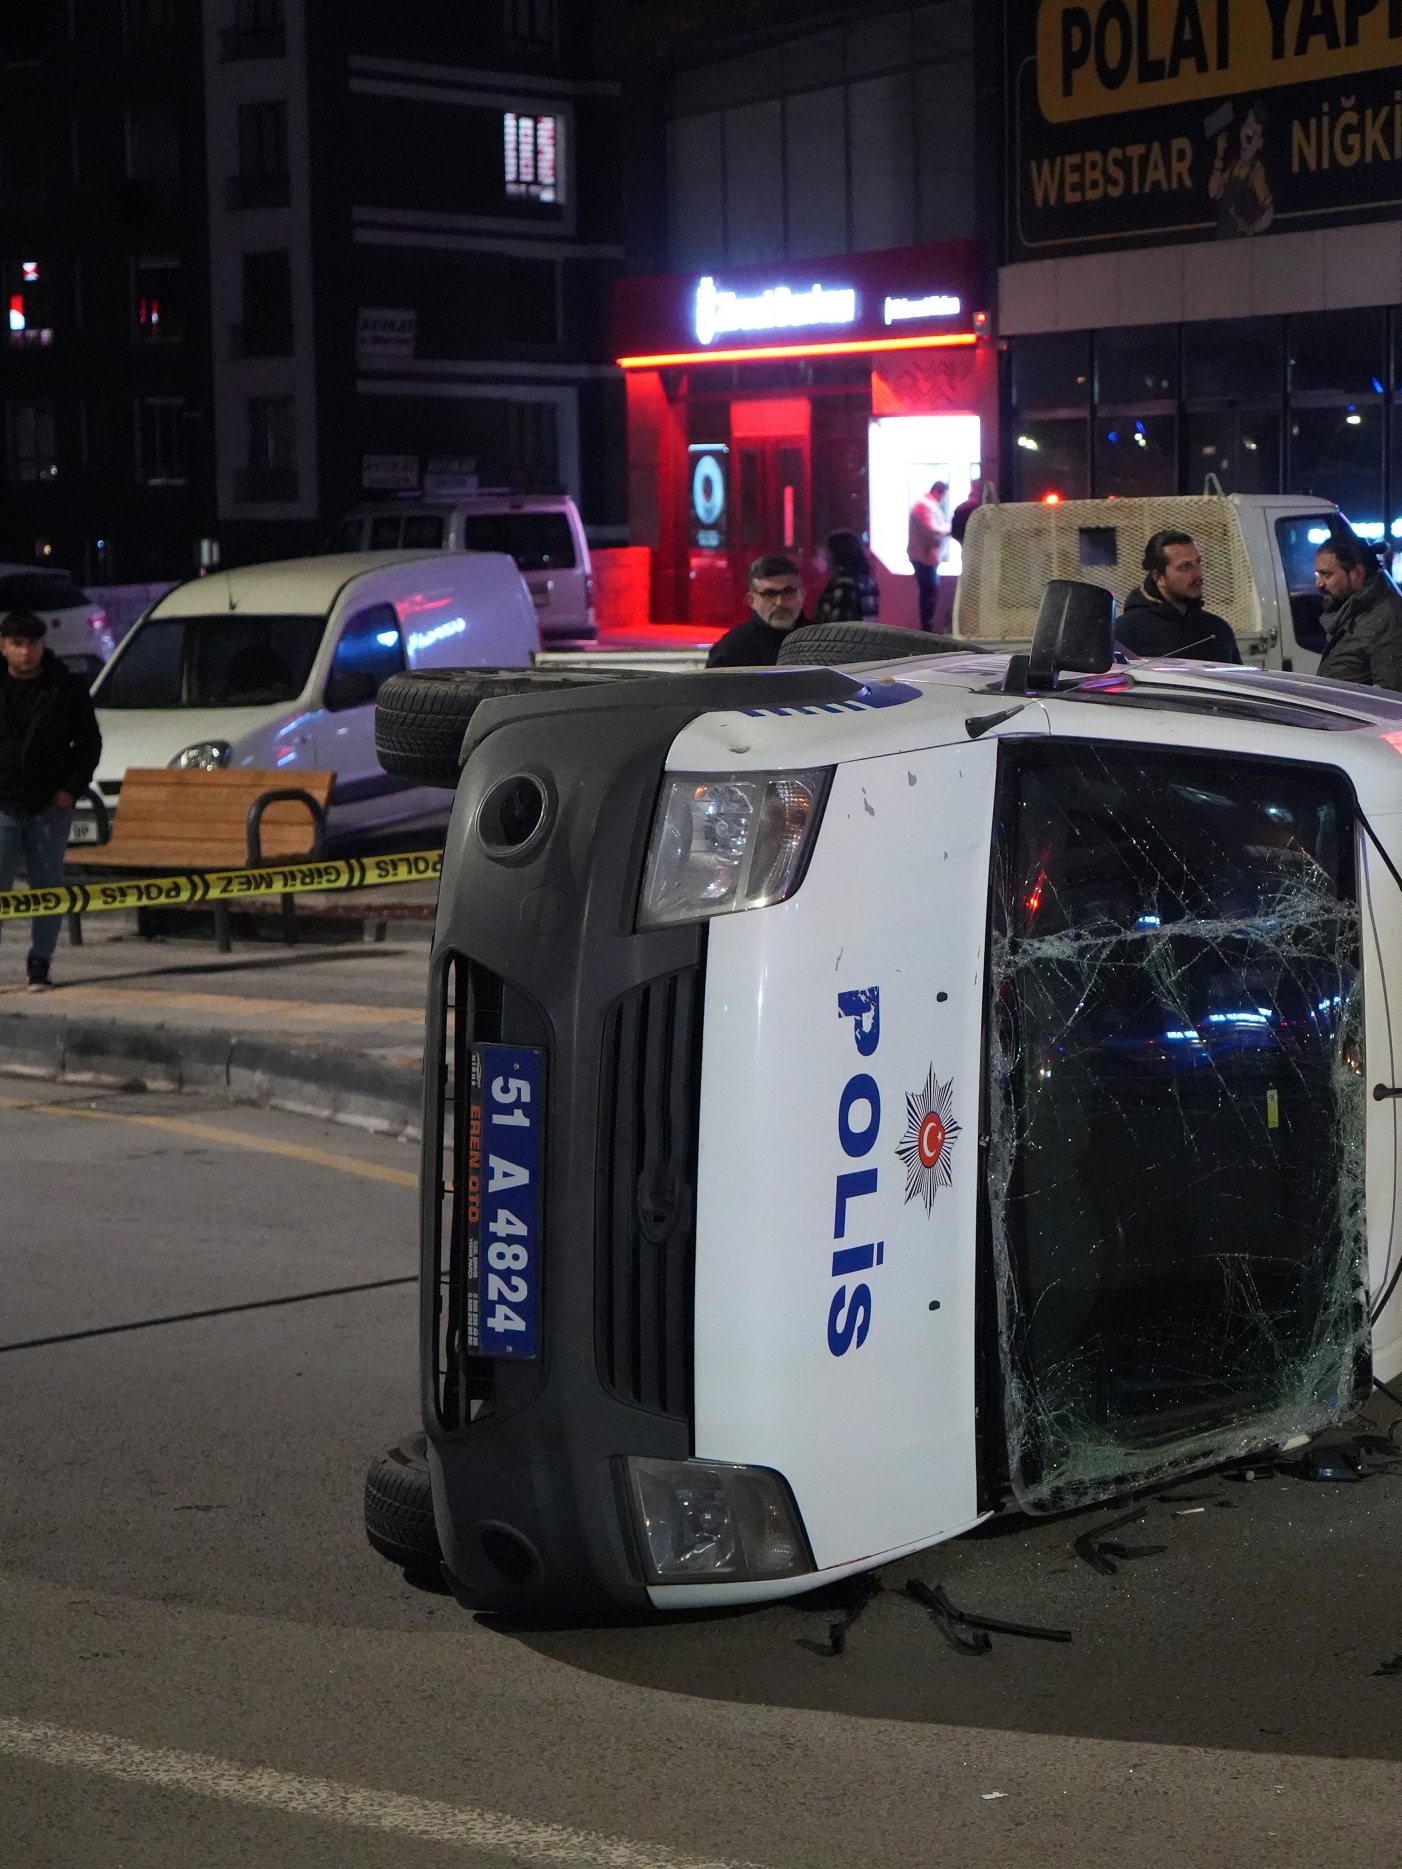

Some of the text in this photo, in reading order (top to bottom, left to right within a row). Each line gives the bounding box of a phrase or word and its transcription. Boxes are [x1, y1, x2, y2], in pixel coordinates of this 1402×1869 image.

[1030, 136, 1194, 208] WEBSTAR
[102, 880, 181, 906] POLİS
[217, 863, 341, 894] GİRİLMEZ
[469, 1105, 481, 1168] EREN
[468, 1175, 480, 1223] OTO
[826, 985, 884, 1358] POLİS
[486, 1075, 531, 1333] 51 A 4824
